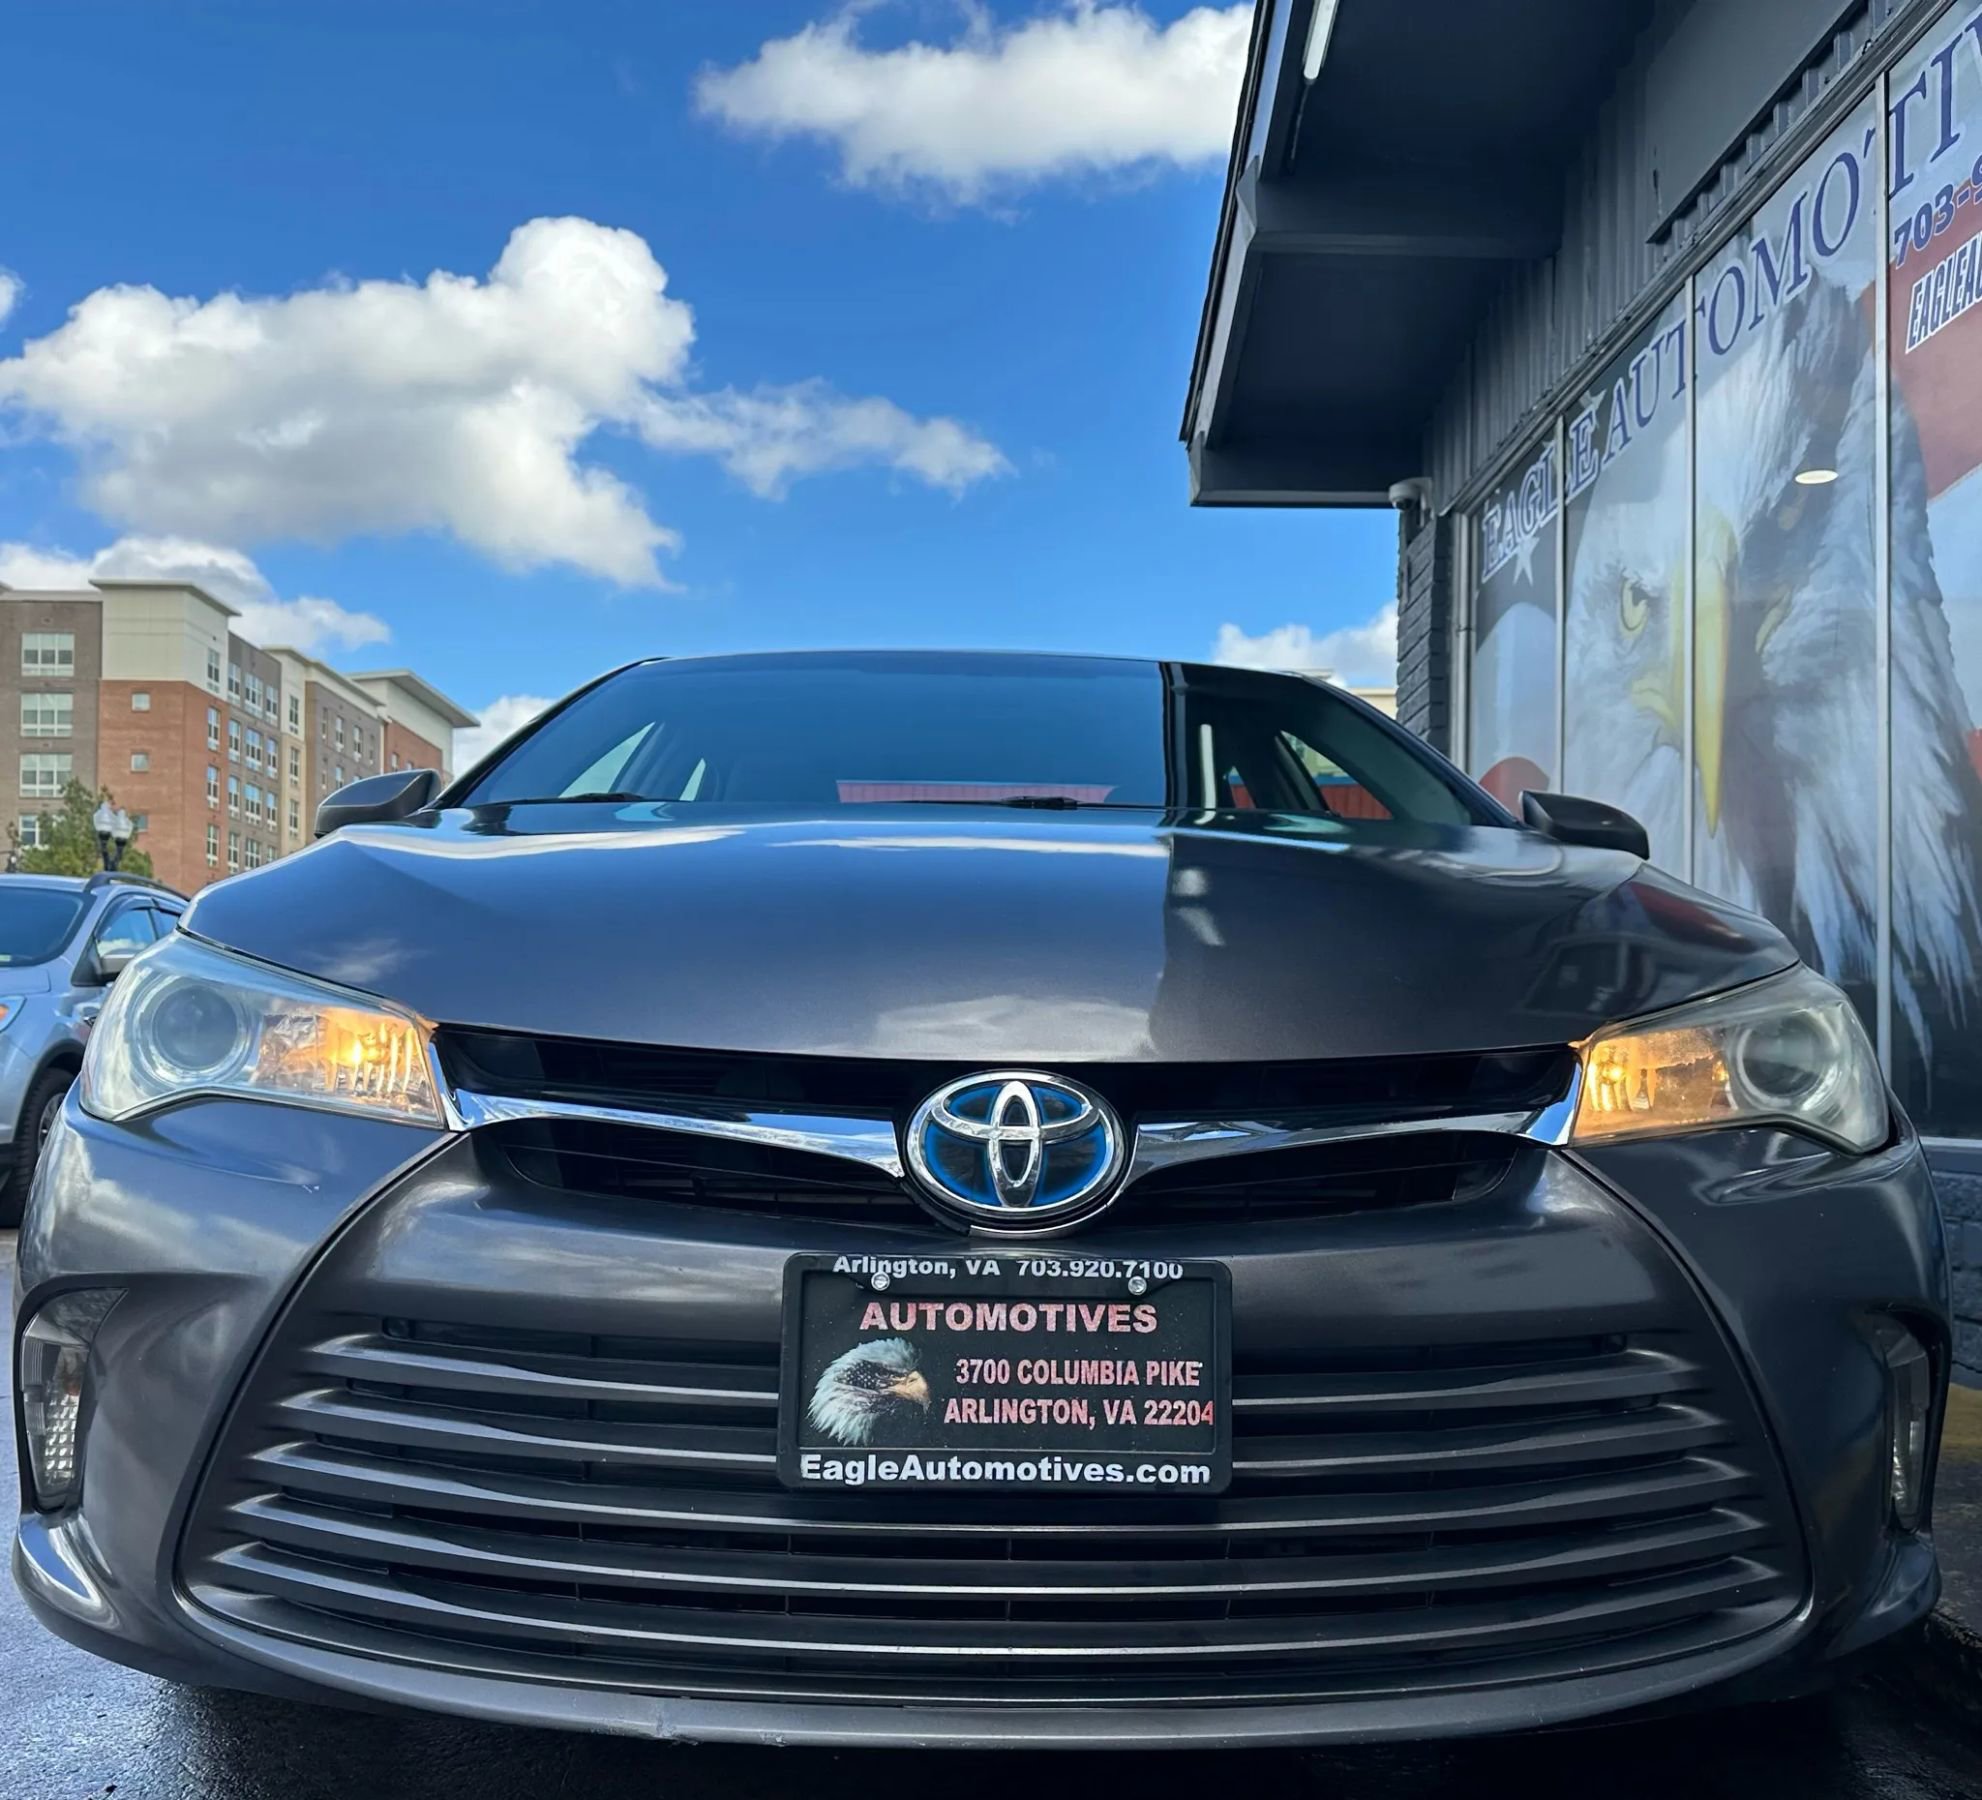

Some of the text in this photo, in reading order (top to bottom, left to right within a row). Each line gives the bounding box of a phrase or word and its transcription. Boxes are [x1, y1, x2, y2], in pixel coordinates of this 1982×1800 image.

[1481, 12, 1982, 584] EAGLE AUTOMOTI
[832, 1255, 1184, 1280] Arlington, VA 703.920.7100
[859, 1302, 1159, 1334] AUTOMOTIVES
[955, 1359, 1201, 1387] 3700 COLUMBIA PIKE
[943, 1399, 1214, 1431] ARLINGTON, VA 22204
[800, 1454, 1211, 1486] EagleAutomotives.com
